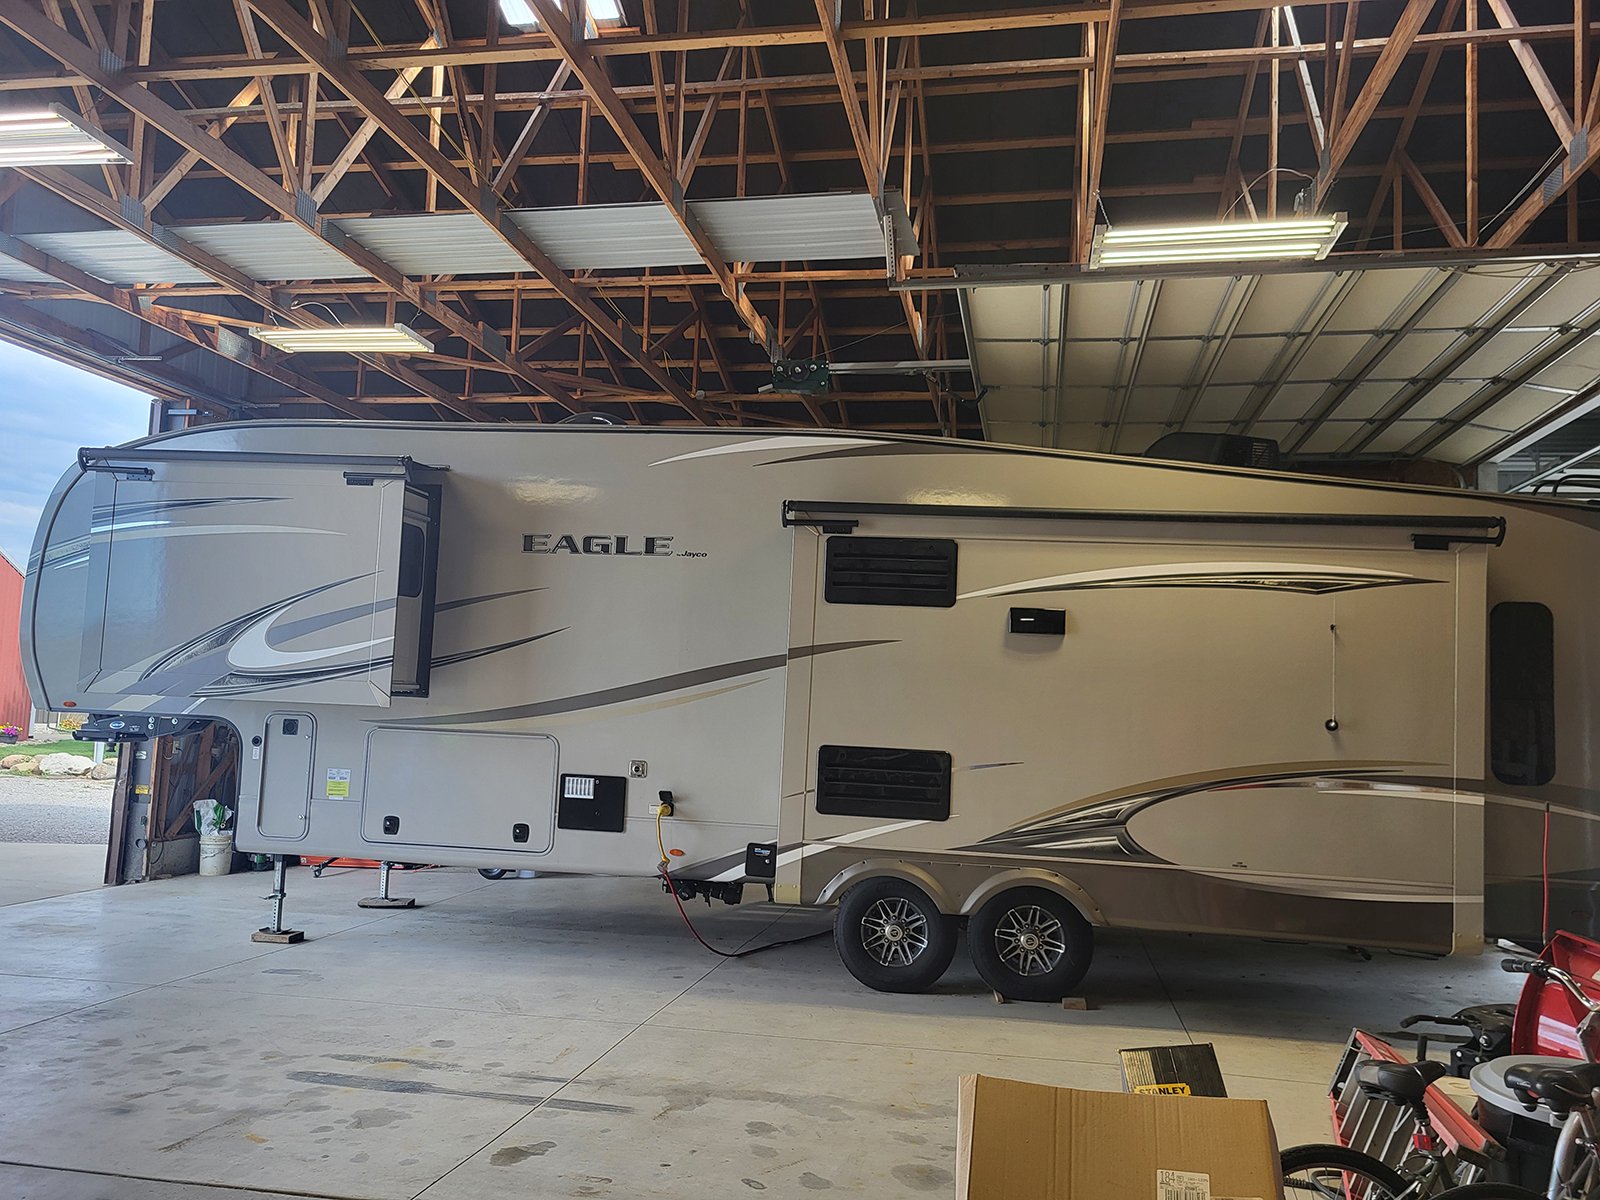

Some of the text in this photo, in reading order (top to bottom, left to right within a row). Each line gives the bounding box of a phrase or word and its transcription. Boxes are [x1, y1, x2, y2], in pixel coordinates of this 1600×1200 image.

[521, 533, 674, 557] EAGLE
[681, 550, 708, 559] Jayco
[1139, 1086, 1186, 1096] STANLEY
[1159, 1170, 1176, 1184] 184
